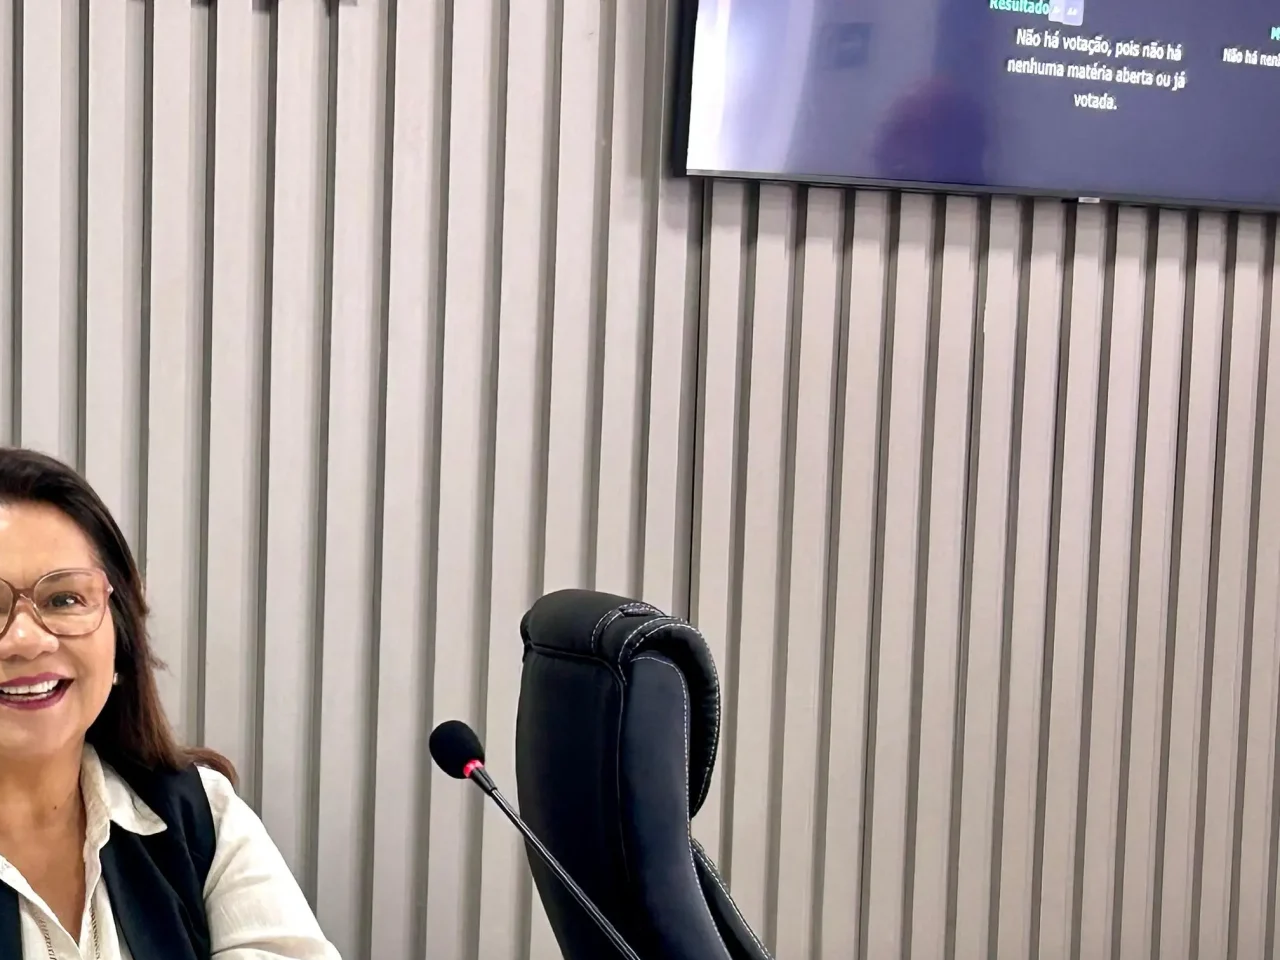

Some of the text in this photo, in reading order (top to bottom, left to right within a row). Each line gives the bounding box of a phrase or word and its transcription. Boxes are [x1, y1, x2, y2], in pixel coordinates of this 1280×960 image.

[989, 0, 1050, 14] Resultado
[1016, 28, 1182, 62] Não há votação, pois não há
[1007, 57, 1186, 92] nenhuma matéria aberta ou já
[1074, 92, 1117, 110] votada.
